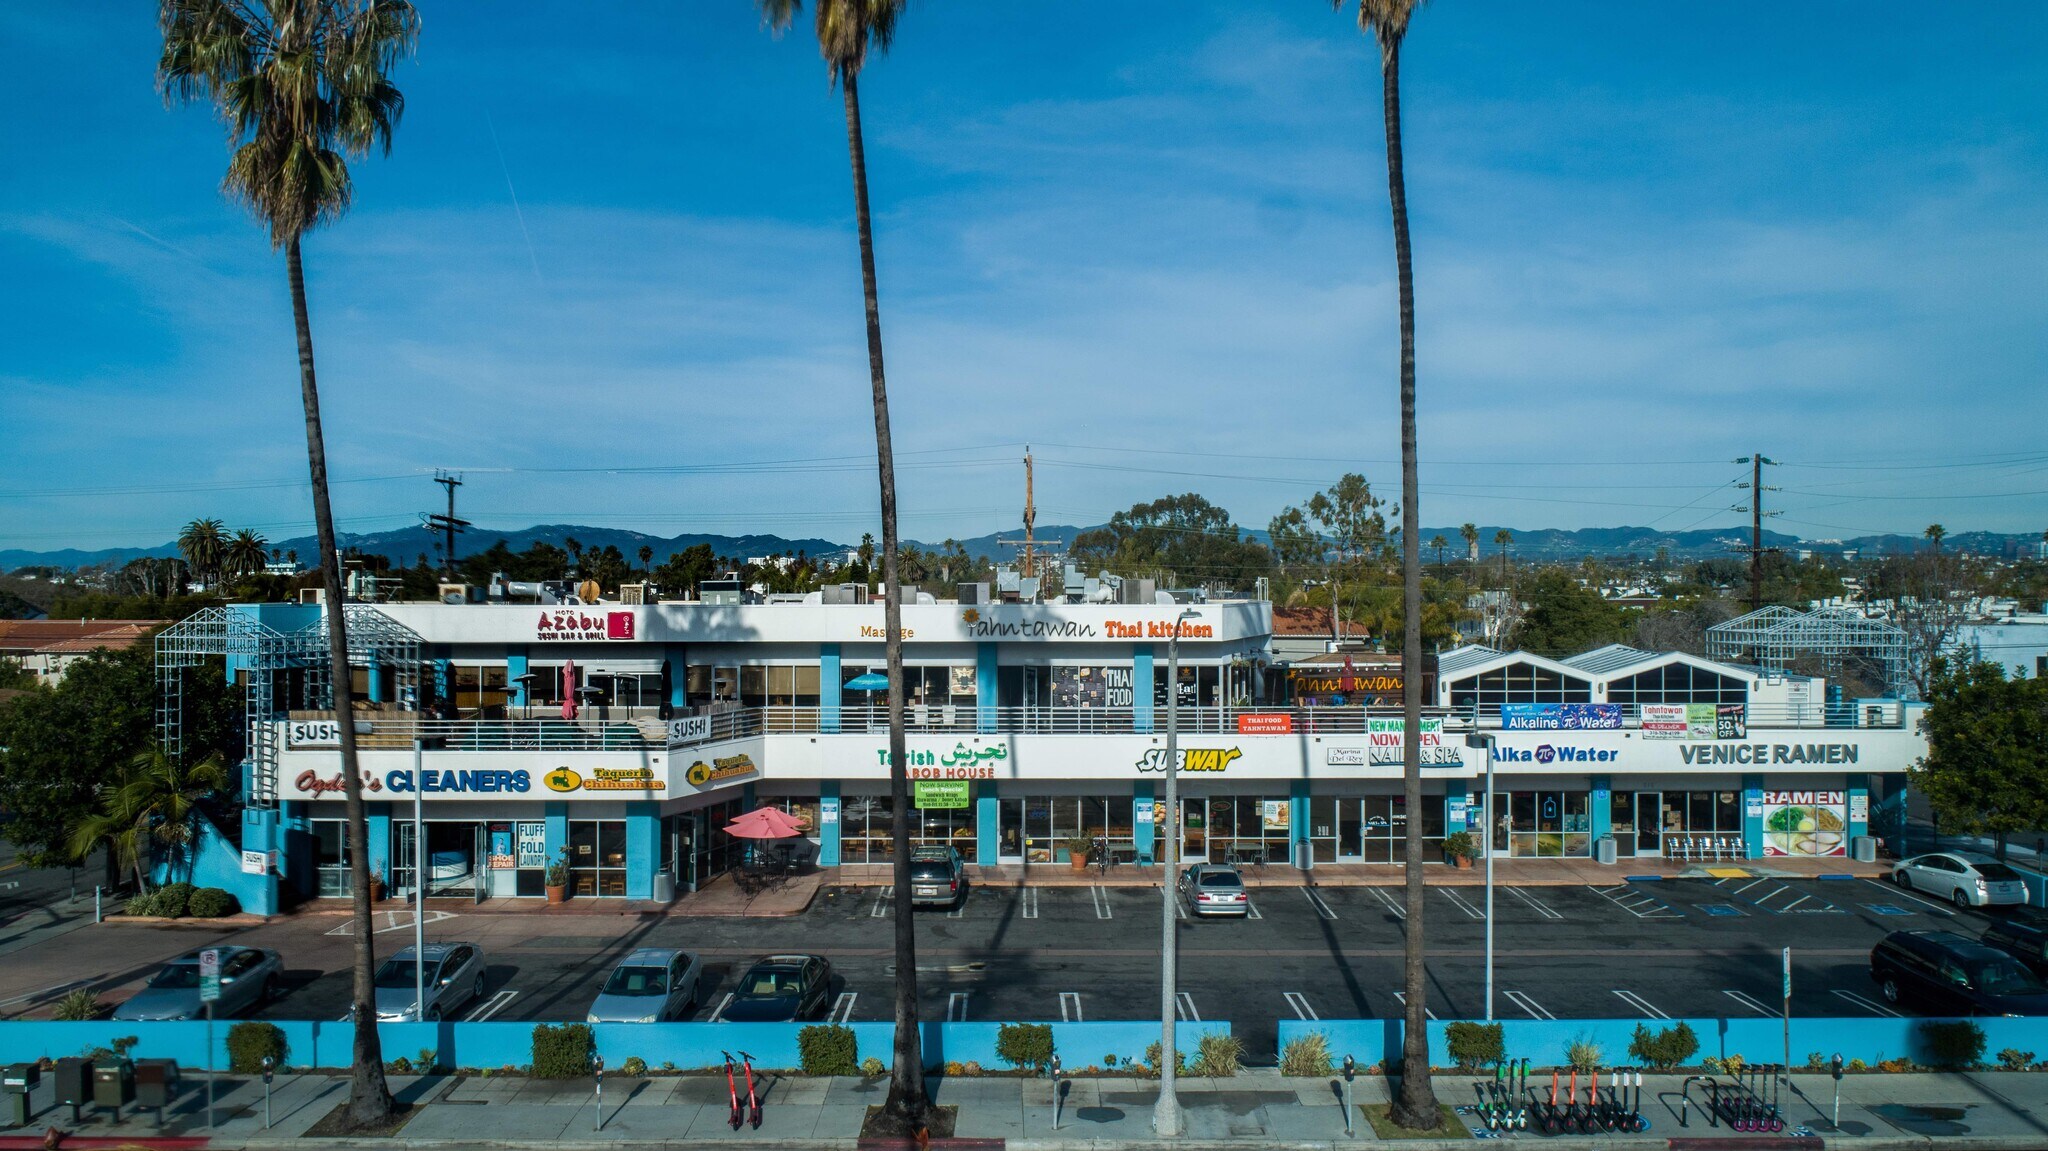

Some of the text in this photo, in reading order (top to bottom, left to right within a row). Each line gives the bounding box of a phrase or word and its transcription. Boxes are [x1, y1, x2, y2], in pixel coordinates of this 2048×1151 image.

[538, 612, 605, 631] Azabu
[537, 632, 559, 640] SUSHI
[561, 632, 575, 640] BAR
[585, 632, 605, 640] GRILL
[860, 626, 915, 639] Masge
[1104, 621, 1213, 638] Thai kitchen
[1107, 669, 1133, 687] THAI
[1107, 689, 1132, 706] FOOD
[673, 719, 706, 738] SUSHI
[1369, 720, 1386, 732] NEW
[1509, 716, 1558, 729] Alkaline
[1580, 716, 1617, 729] Water
[295, 724, 343, 741] SUSH
[1370, 734, 1400, 746] NOW
[1136, 747, 1242, 773] SUBWAY
[1434, 747, 1462, 764] SPA
[1493, 747, 1533, 762] Alka
[1557, 747, 1618, 762] Water
[1679, 744, 1858, 764] VENICE RAMEN
[716, 755, 749, 767] Taqueria
[593, 768, 653, 778] Taqueria
[710, 765, 755, 780] Chihuahua
[946, 768, 995, 778] HOUSE
[386, 769, 531, 793] CLEANERS
[583, 780, 665, 790] Chihuahua
[1762, 791, 1843, 804] RAMEN
[519, 825, 544, 836] FLUFF
[520, 842, 544, 853] FOLD
[520, 854, 544, 866] LAUNDRY
